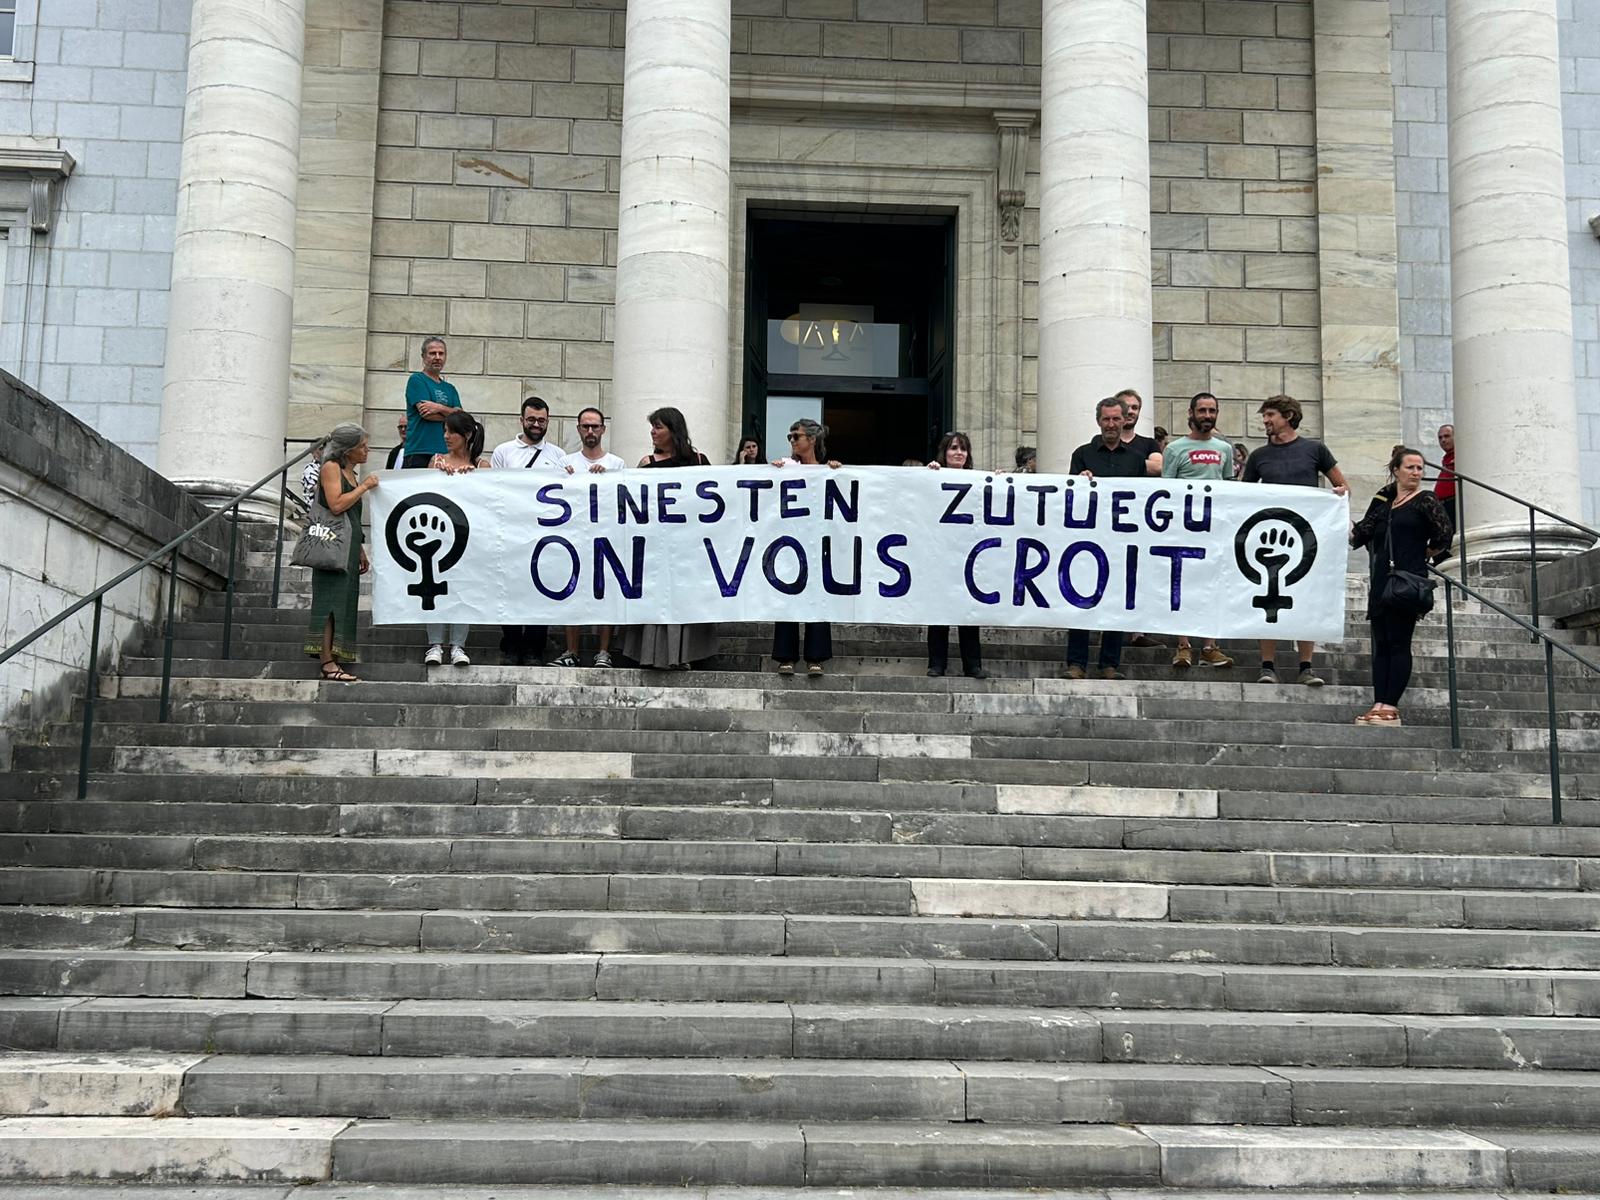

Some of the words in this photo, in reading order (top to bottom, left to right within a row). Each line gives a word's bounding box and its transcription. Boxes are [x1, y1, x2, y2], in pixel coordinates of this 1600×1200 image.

[535, 478, 861, 527] SINESTEN
[939, 476, 1213, 533] ZÜTÜEGÜ
[530, 534, 646, 602] ON
[702, 534, 912, 598] VOUS
[963, 537, 1207, 612] CROIT
